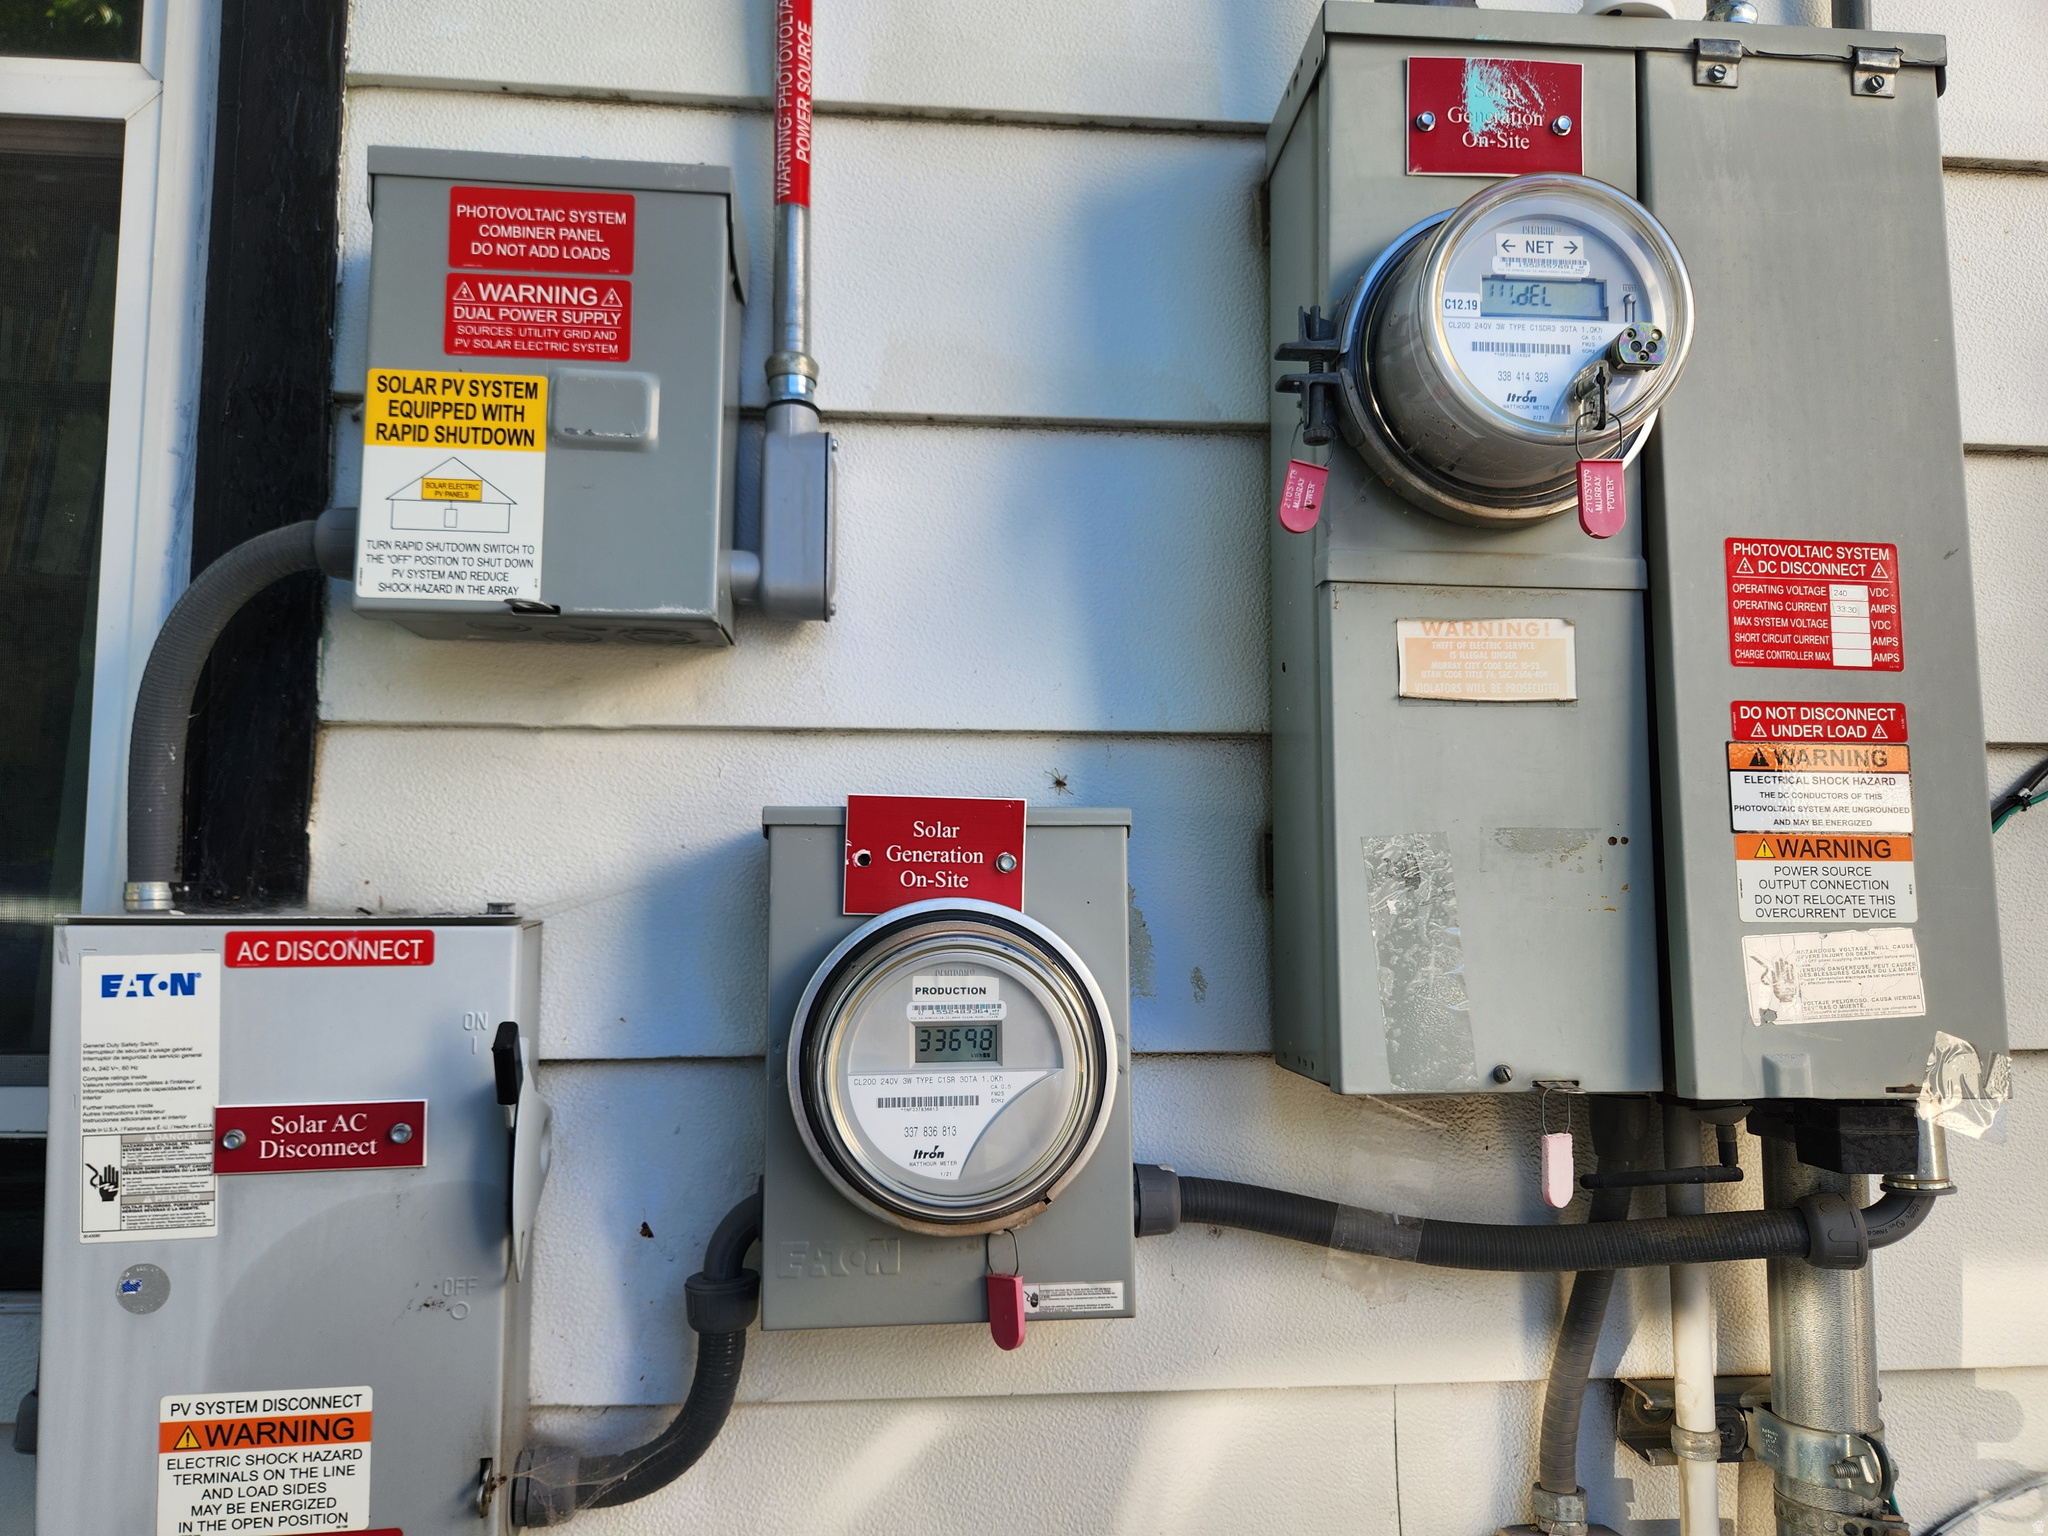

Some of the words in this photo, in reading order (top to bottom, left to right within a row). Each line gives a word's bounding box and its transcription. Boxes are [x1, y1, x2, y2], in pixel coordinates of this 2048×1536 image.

[798, 21, 812, 95] SOURCE
[1448, 107, 1543, 126] Generation
[796, 97, 811, 164] POWER
[1462, 131, 1530, 149] On-Site
[777, 113, 792, 199] WARNING:
[457, 205, 566, 223] PHOTOVOLTAIC
[569, 210, 626, 225] SYSTEM
[479, 225, 556, 240] COMBINER
[559, 228, 604, 242] PANEL
[471, 243, 493, 255] DO
[496, 244, 526, 256] NOT
[529, 245, 559, 258] ADD
[563, 247, 611, 261] LOADS
[1526, 241, 1554, 254] NET
[478, 283, 598, 306] WARNING
[1445, 299, 1478, 310] C12.19
[453, 307, 495, 320] DUAL
[500, 308, 557, 323] POWER
[562, 311, 621, 325] SUPPLY
[457, 325, 516, 336] SOURCES:
[518, 328, 560, 338] UTILITY
[563, 329, 591, 340] GRID
[594, 331, 617, 341] AND
[454, 339, 470, 348] PV
[473, 339, 512, 350] SOLAR
[514, 341, 569, 352] ELECTRIC
[572, 343, 618, 354] SYSTEM
[1498, 371, 1511, 381] 338
[1516, 372, 1530, 382] 414
[1535, 372, 1549, 382] 328
[377, 376, 436, 395] SOLAR
[442, 379, 464, 396] PV
[469, 380, 538, 399] SYSTEM
[1507, 390, 1537, 403] Itron
[389, 400, 477, 420] EQUIPPED
[482, 403, 525, 422] WITH
[376, 423, 429, 442] RAPID
[434, 426, 535, 447] SHUTDOWN
[367, 540, 392, 550] TURN
[395, 541, 423, 551] RAPID
[426, 542, 481, 553] SHUTDOWN
[484, 544, 519, 554] SWITCH
[522, 545, 535, 554] TO
[1733, 543, 1833, 559] PHOTOVOLTAIC
[1837, 547, 1889, 561] SYSTEM
[1758, 561, 1777, 574] DC
[1781, 562, 1867, 576] DISCONNECT
[1733, 583, 1784, 595] OPERATING
[1786, 586, 1827, 597] VOLTAGE
[1870, 588, 1889, 597] VDC
[1733, 601, 1784, 611] OPERATING
[1786, 602, 1828, 612] CURRENT
[1836, 606, 1857, 614] 33.30
[1871, 605, 1897, 614] AMPS
[1421, 621, 1550, 637] WARNING!
[1415, 683, 1461, 694] VIOLATORS
[1466, 684, 1486, 693] WILL
[1491, 683, 1501, 693] BE
[1506, 683, 1560, 694] PROSECUTED
[1740, 706, 1762, 720] DO
[1766, 706, 1796, 720] NOT
[1800, 707, 1896, 721] DISCONNECT
[1771, 725, 1823, 738] UNDER
[1827, 725, 1867, 738] LOAD
[1773, 748, 1888, 767] WARNING
[1745, 776, 1809, 785] ELECTRICAL
[1812, 777, 1849, 786] SHOCK
[1853, 777, 1896, 786] HAZARD
[913, 821, 960, 838] Solar
[886, 845, 984, 864] Generation
[1776, 839, 1891, 859] WARNING
[900, 870, 969, 888] On-Site
[1774, 866, 1818, 877] POWER
[1822, 867, 1872, 877] SOURCE
[1759, 880, 1806, 889] OUTPUT
[1810, 880, 1889, 890] CONNECTION
[1755, 895, 1772, 904] DO
[1776, 895, 1799, 904] NOT
[1804, 895, 1866, 905] RELOCATE
[1869, 895, 1895, 905] THIS
[1756, 908, 1846, 918] OVERCURRENT
[1853, 909, 1897, 918] DEVICE
[237, 942, 269, 961] AC
[276, 940, 424, 961] DISCONNECT
[915, 987, 986, 995] PRODUCTION
[463, 1011, 488, 1031] ON
[920, 1029, 993, 1052] 33698
[271, 1115, 327, 1135] Solar
[332, 1113, 368, 1133] AC
[904, 1127, 918, 1137] 337
[923, 1126, 937, 1137] 836
[943, 1126, 957, 1136] 813
[259, 1139, 378, 1159] Disconnect
[913, 1146, 944, 1159] Itron
[443, 1277, 479, 1297] OFF
[171, 1403, 191, 1416] PV
[195, 1400, 258, 1415] SYSTEM
[263, 1394, 363, 1412] DISCONNECT
[205, 1417, 355, 1447] WARNING
[167, 1456, 240, 1470] ELECTRIC
[245, 1452, 298, 1466] SHOCK
[303, 1449, 363, 1462] HAZARD
[173, 1471, 258, 1485] TERMINALS
[264, 1470, 285, 1481] ON
[289, 1467, 318, 1479] THE
[323, 1465, 356, 1477] LINE
[202, 1487, 233, 1500] AND
[238, 1485, 278, 1498] LOAD
[283, 1483, 327, 1494] SIDES
[191, 1504, 222, 1517] MAY
[227, 1503, 246, 1514] BE
[250, 1498, 337, 1513] ENERGIZED
[179, 1522, 192, 1533] IN
[198, 1519, 226, 1532] THE
[231, 1517, 274, 1530] OPEN
[278, 1513, 348, 1528] POSITION
